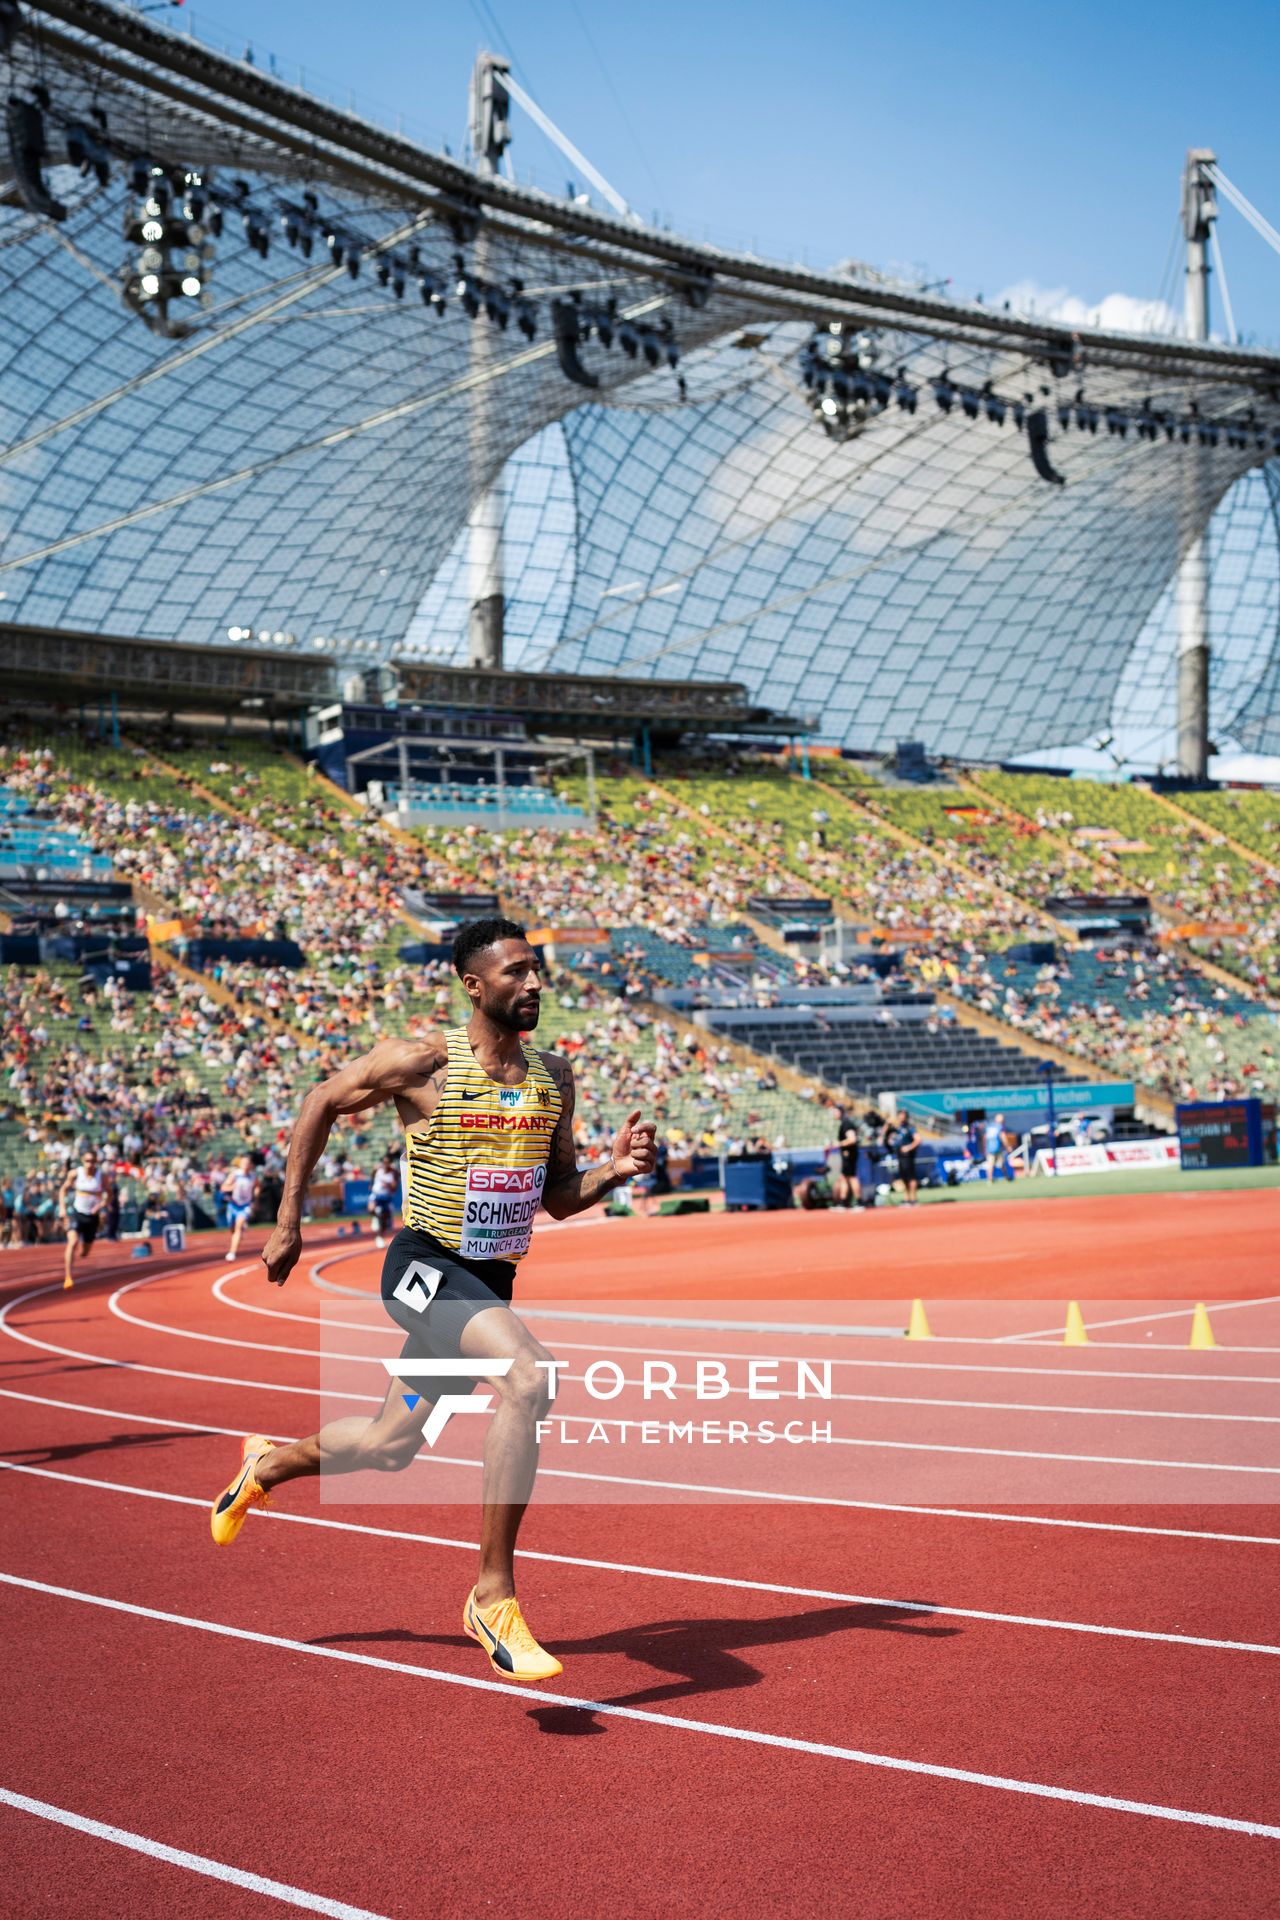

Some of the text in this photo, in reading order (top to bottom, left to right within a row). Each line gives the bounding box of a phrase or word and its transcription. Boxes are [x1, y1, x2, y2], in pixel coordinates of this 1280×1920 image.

[943, 1090, 1092, 1110] Olympiastadion Mnchen
[460, 1113, 549, 1131] GERMANY
[471, 1171, 533, 1190] SPAR
[485, 1226, 529, 1238] I RUN CLEAN
[467, 1239, 512, 1254] MUNICH
[405, 1271, 431, 1300] 7
